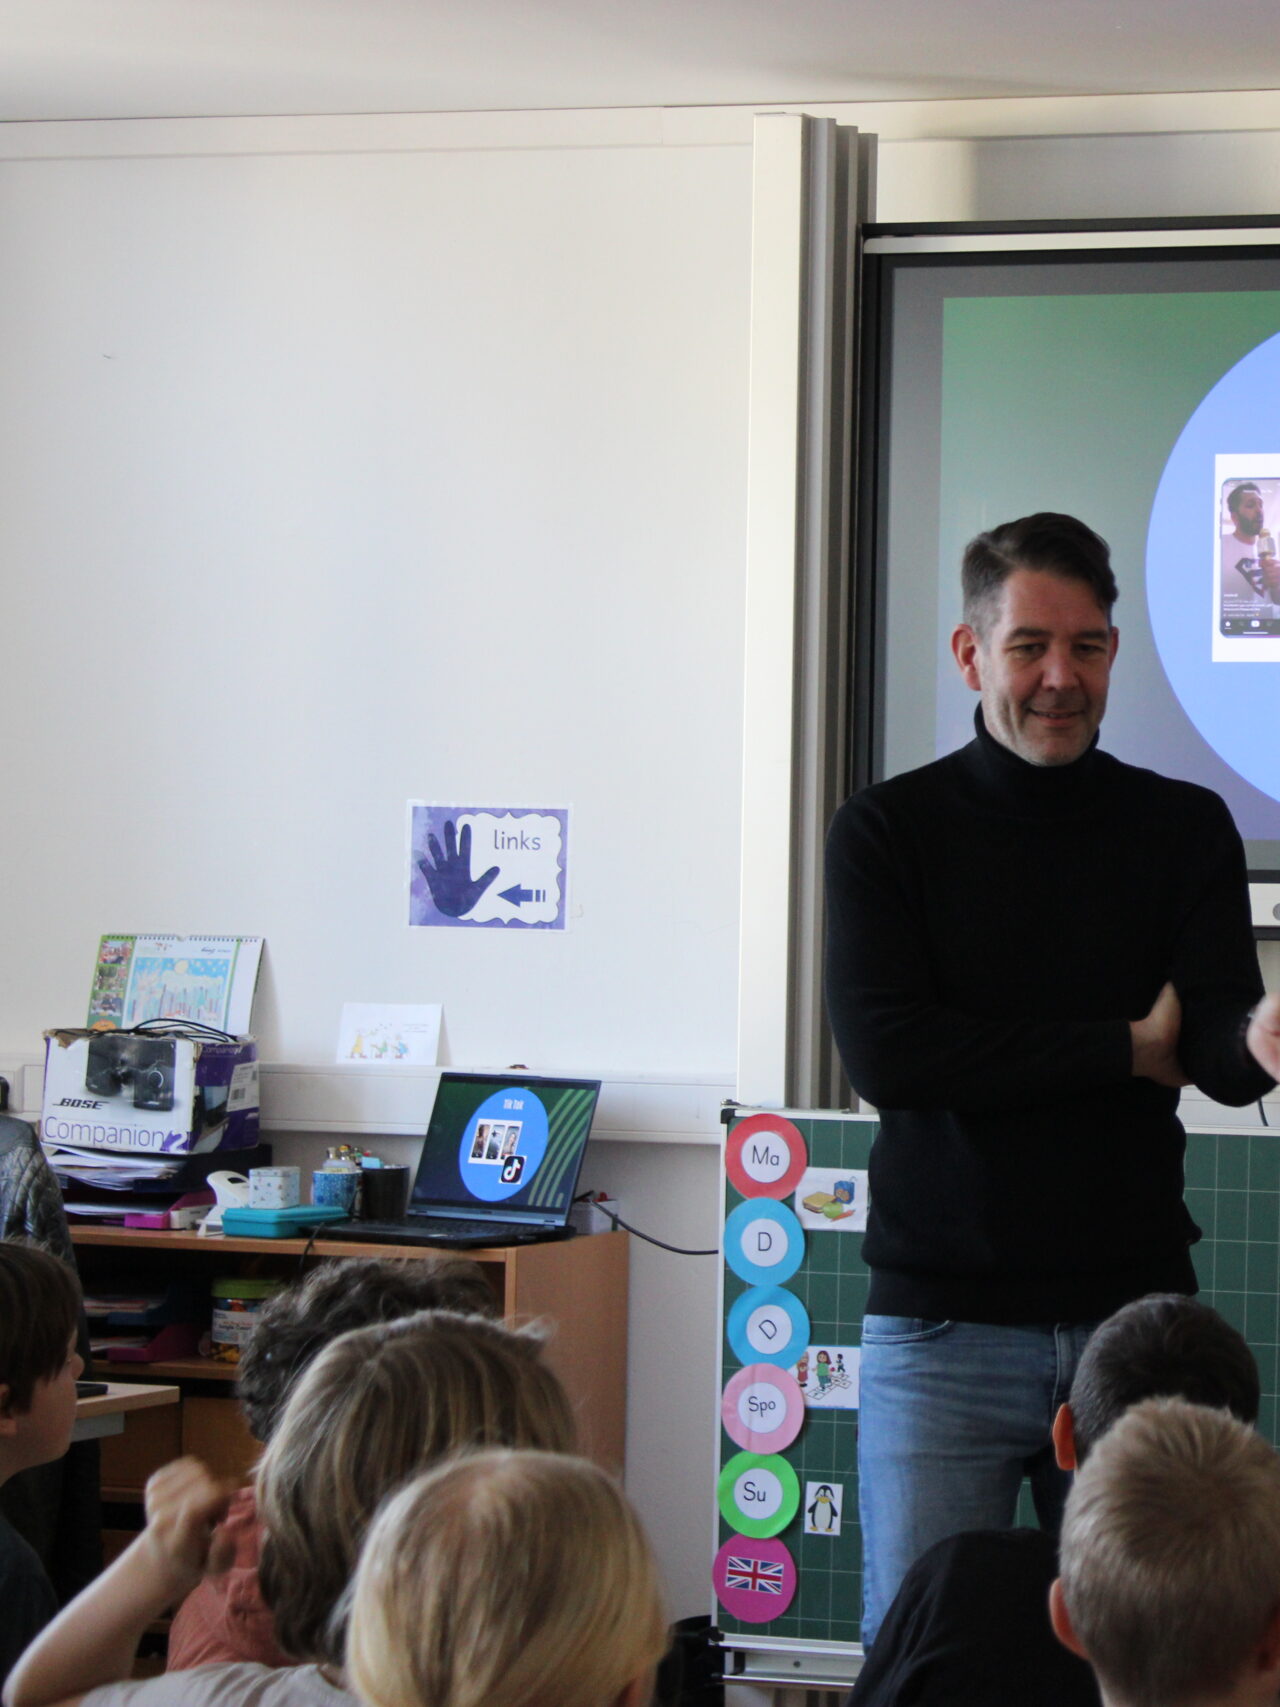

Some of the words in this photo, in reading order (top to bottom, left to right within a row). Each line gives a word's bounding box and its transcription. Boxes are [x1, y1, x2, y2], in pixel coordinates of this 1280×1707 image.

[494, 829, 541, 851] links
[56, 1097, 106, 1110] BOSE
[44, 1115, 164, 1147] Companion
[751, 1144, 780, 1167] Ma
[757, 1231, 773, 1252] D
[759, 1319, 778, 1340] D
[748, 1396, 777, 1418] Spo
[743, 1481, 766, 1502] Su
